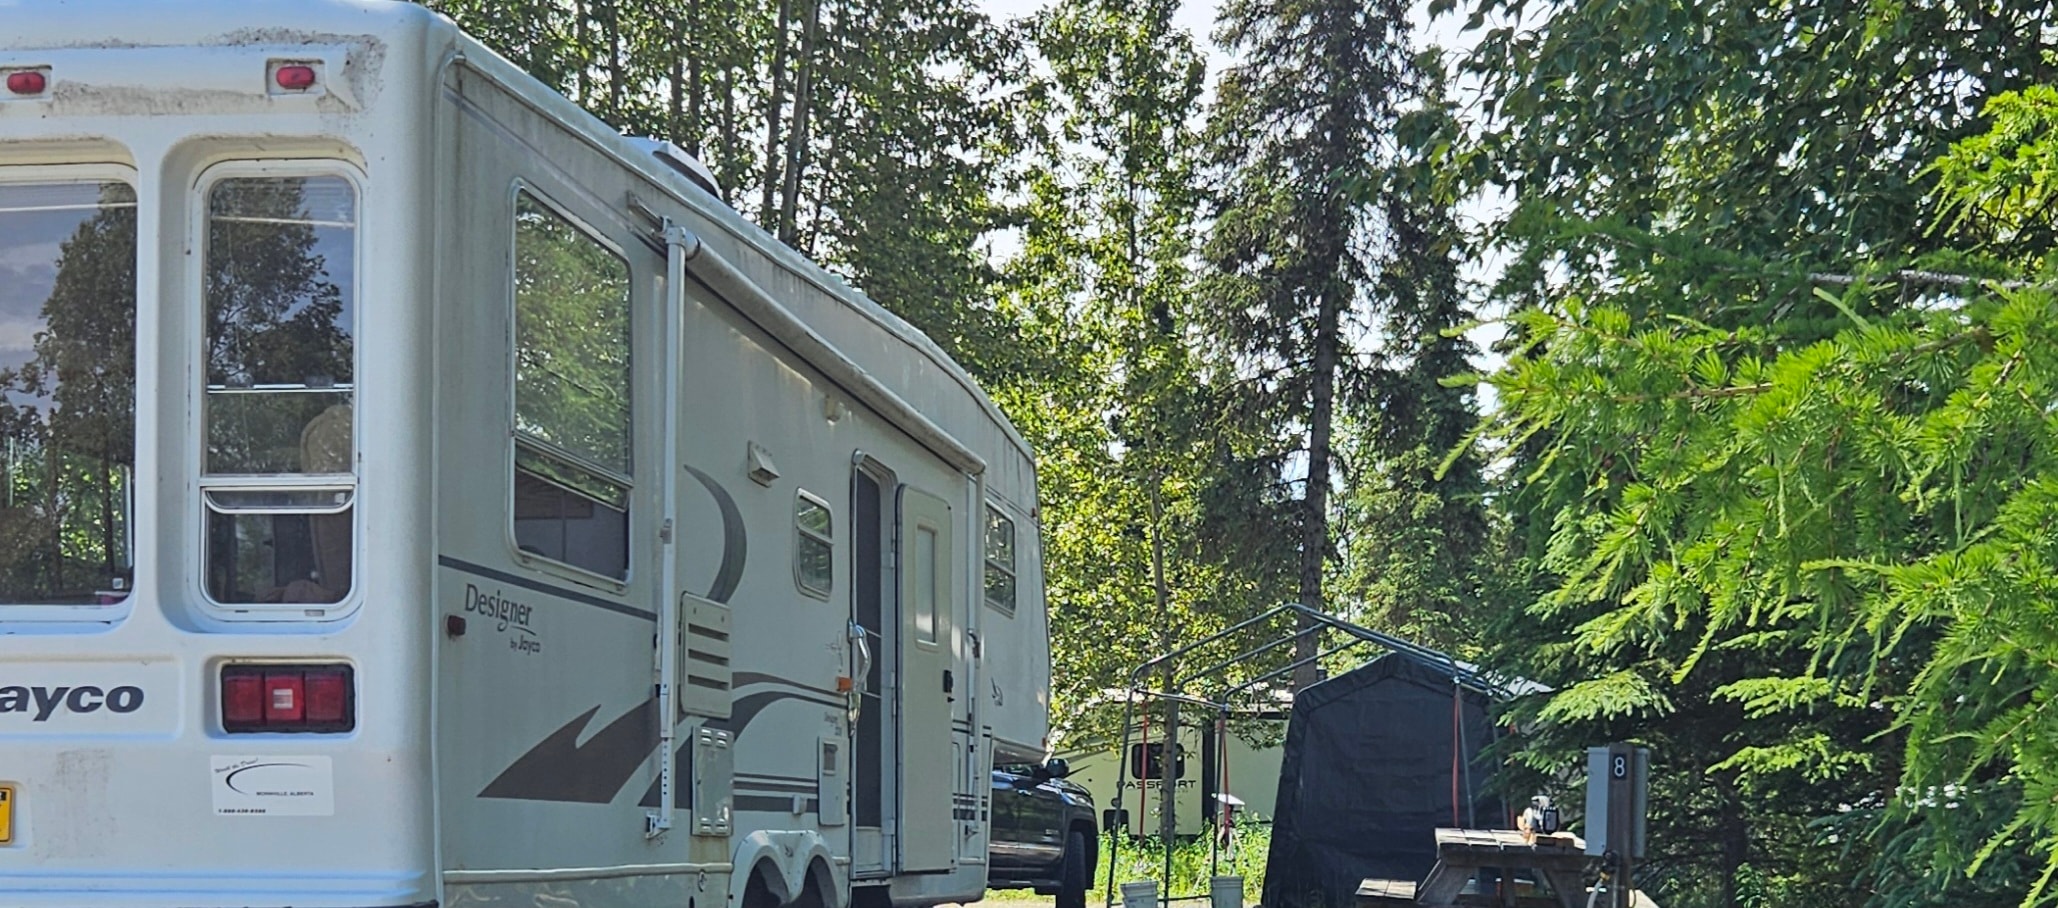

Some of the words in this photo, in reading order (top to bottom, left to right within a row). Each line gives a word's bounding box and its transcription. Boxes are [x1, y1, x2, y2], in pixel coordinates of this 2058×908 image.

[464, 583, 533, 632] Designer
[509, 637, 518, 652] by
[518, 634, 541, 656] Jayco
[1614, 756, 1625, 777] 8
[1116, 780, 1197, 789] PASSPRT
